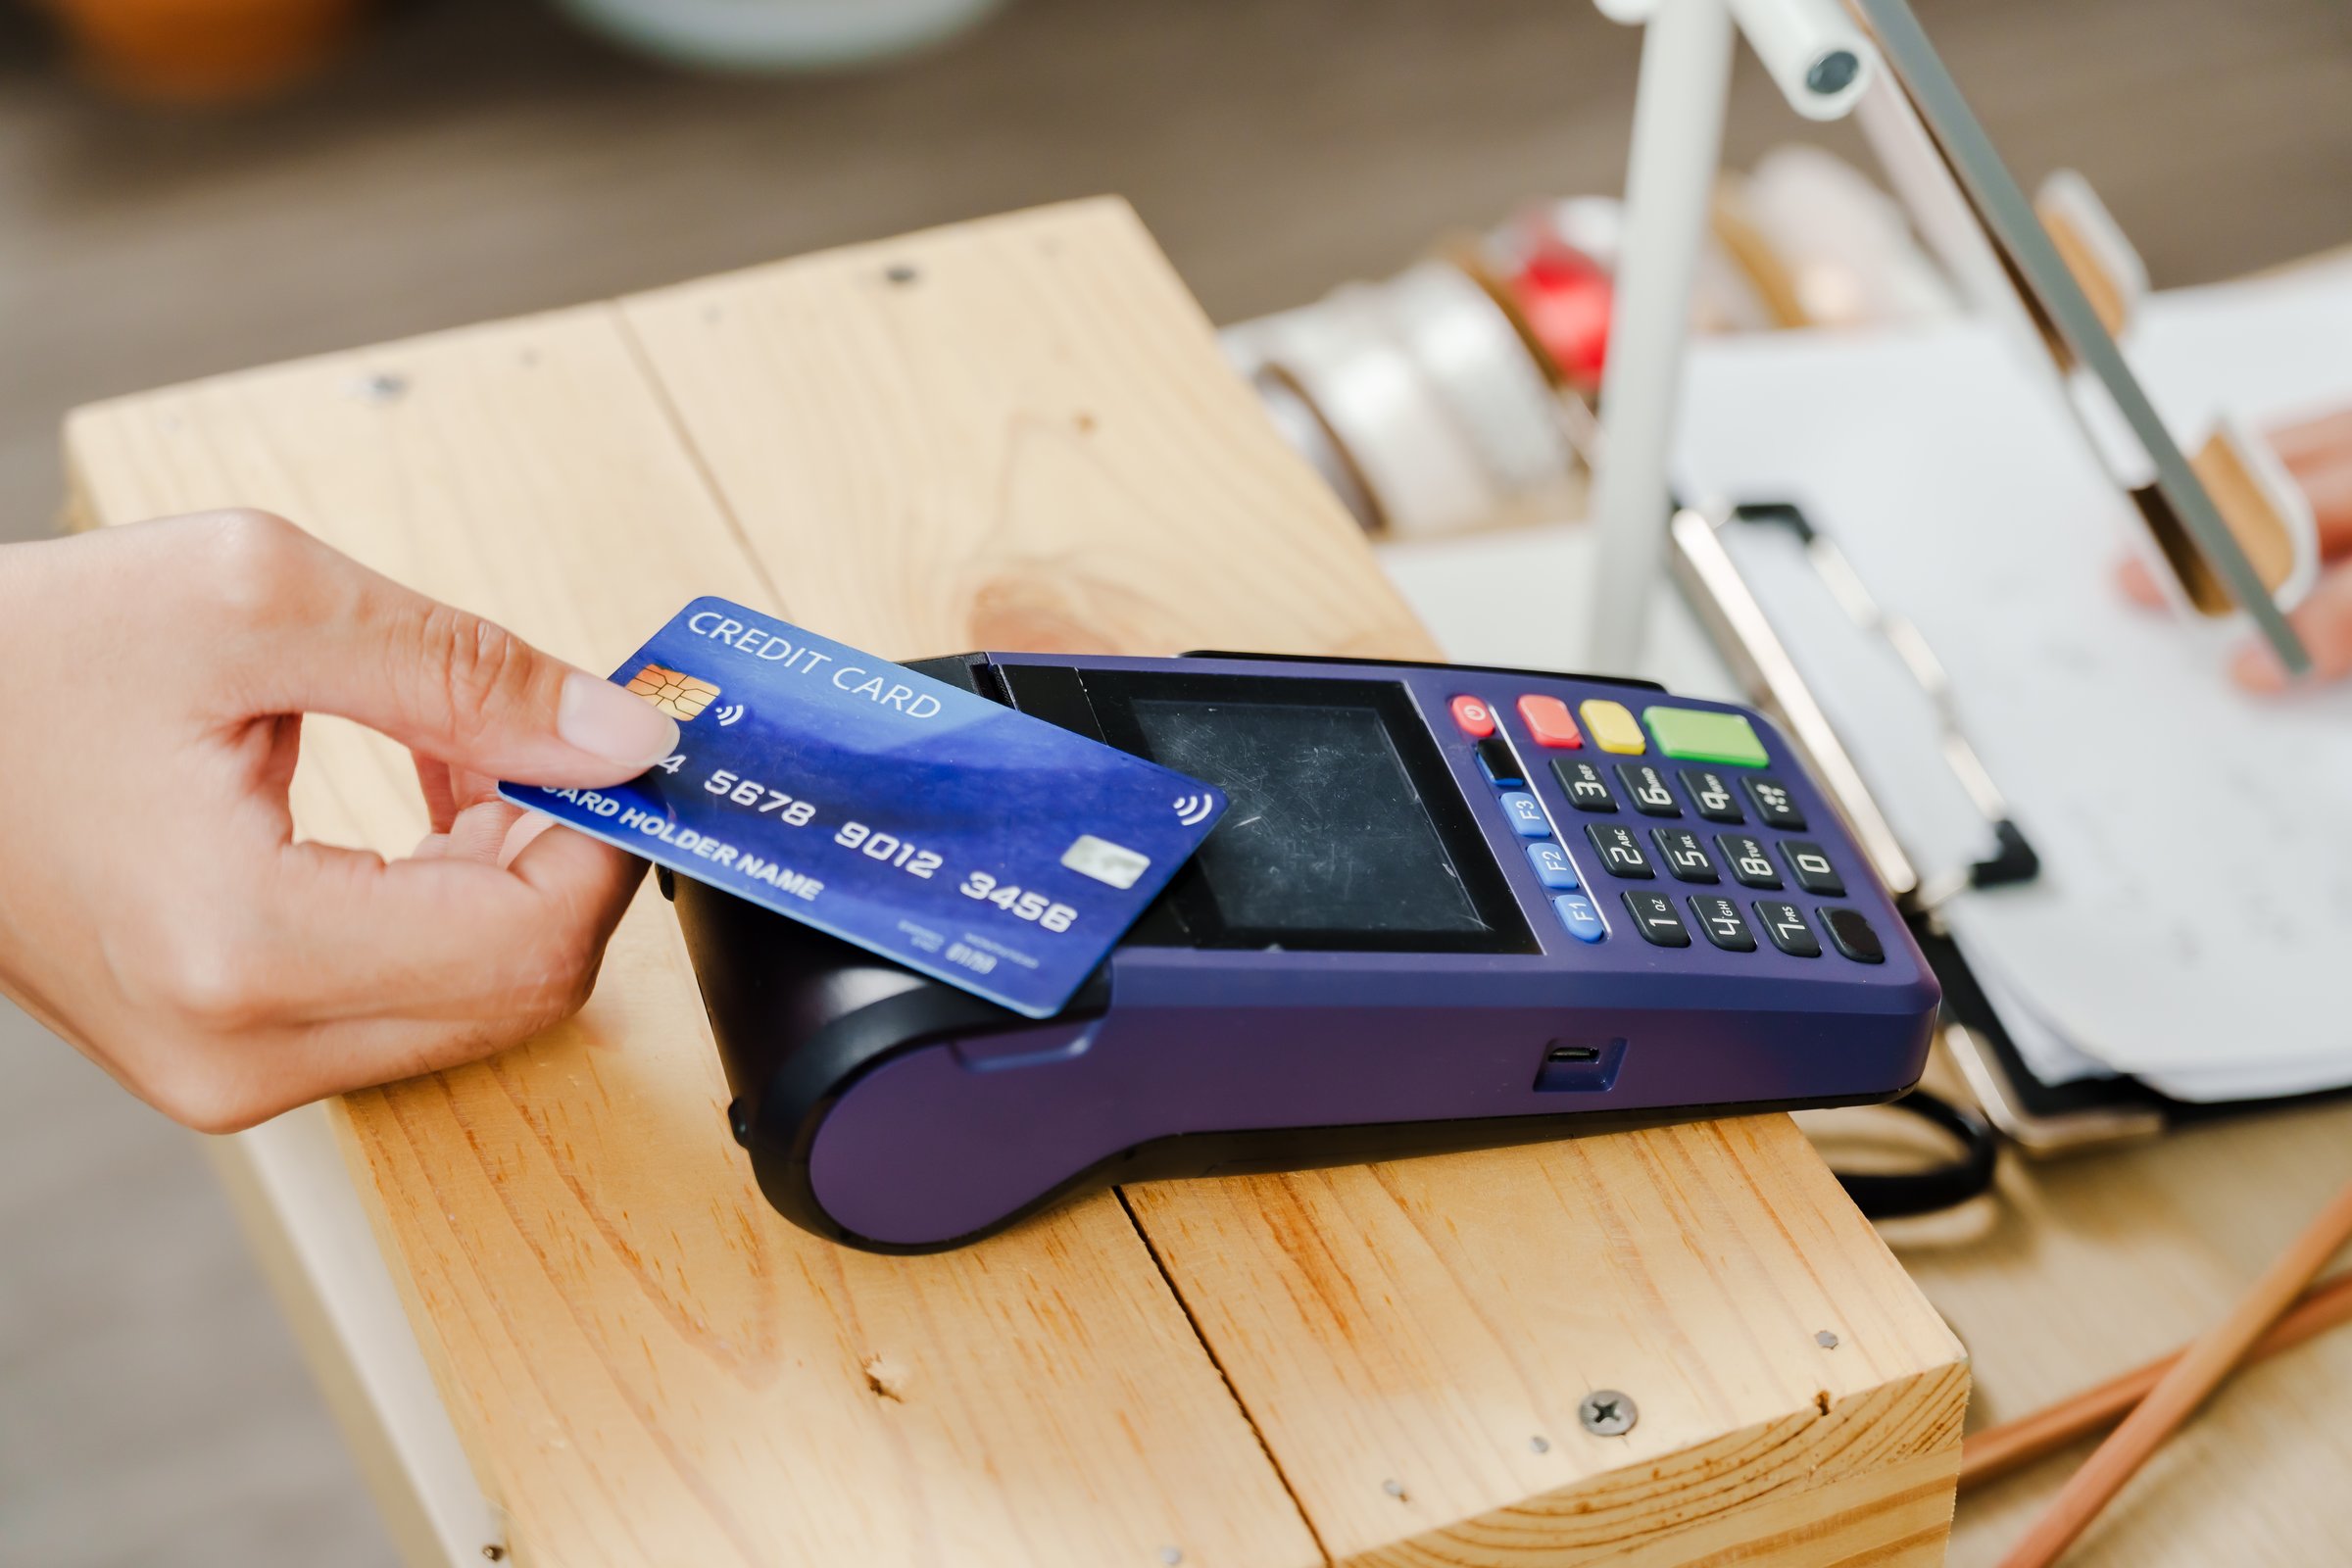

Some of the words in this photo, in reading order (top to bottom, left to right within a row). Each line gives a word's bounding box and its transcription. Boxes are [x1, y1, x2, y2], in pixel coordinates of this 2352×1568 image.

[688, 612, 831, 673] CREDIT
[832, 666, 942, 720] CARD
[1575, 781, 1607, 798] 3
[1638, 787, 1672, 805] 6
[1701, 791, 1730, 809] 9
[1516, 800, 1541, 820] F3
[1614, 829, 1633, 848] ABC
[1681, 835, 1696, 849] JKL
[618, 808, 739, 865] HOLDER
[735, 854, 824, 901] NAME
[704, 769, 816, 828] 5678
[834, 821, 943, 879] 9012
[959, 871, 1078, 933] 3456
[1610, 847, 1642, 865] 2
[1742, 840, 1761, 858] TUV
[1543, 851, 1567, 871] F2
[1674, 851, 1709, 867] 5
[1740, 858, 1773, 876] 8
[1568, 903, 1594, 921] F1
[1651, 899, 1666, 911] QZ
[1717, 901, 1733, 917] GHI
[1648, 918, 1678, 927] 1
[1782, 906, 1799, 923] PRS
[1712, 917, 1740, 936] 4
[1777, 923, 1805, 940] 7
